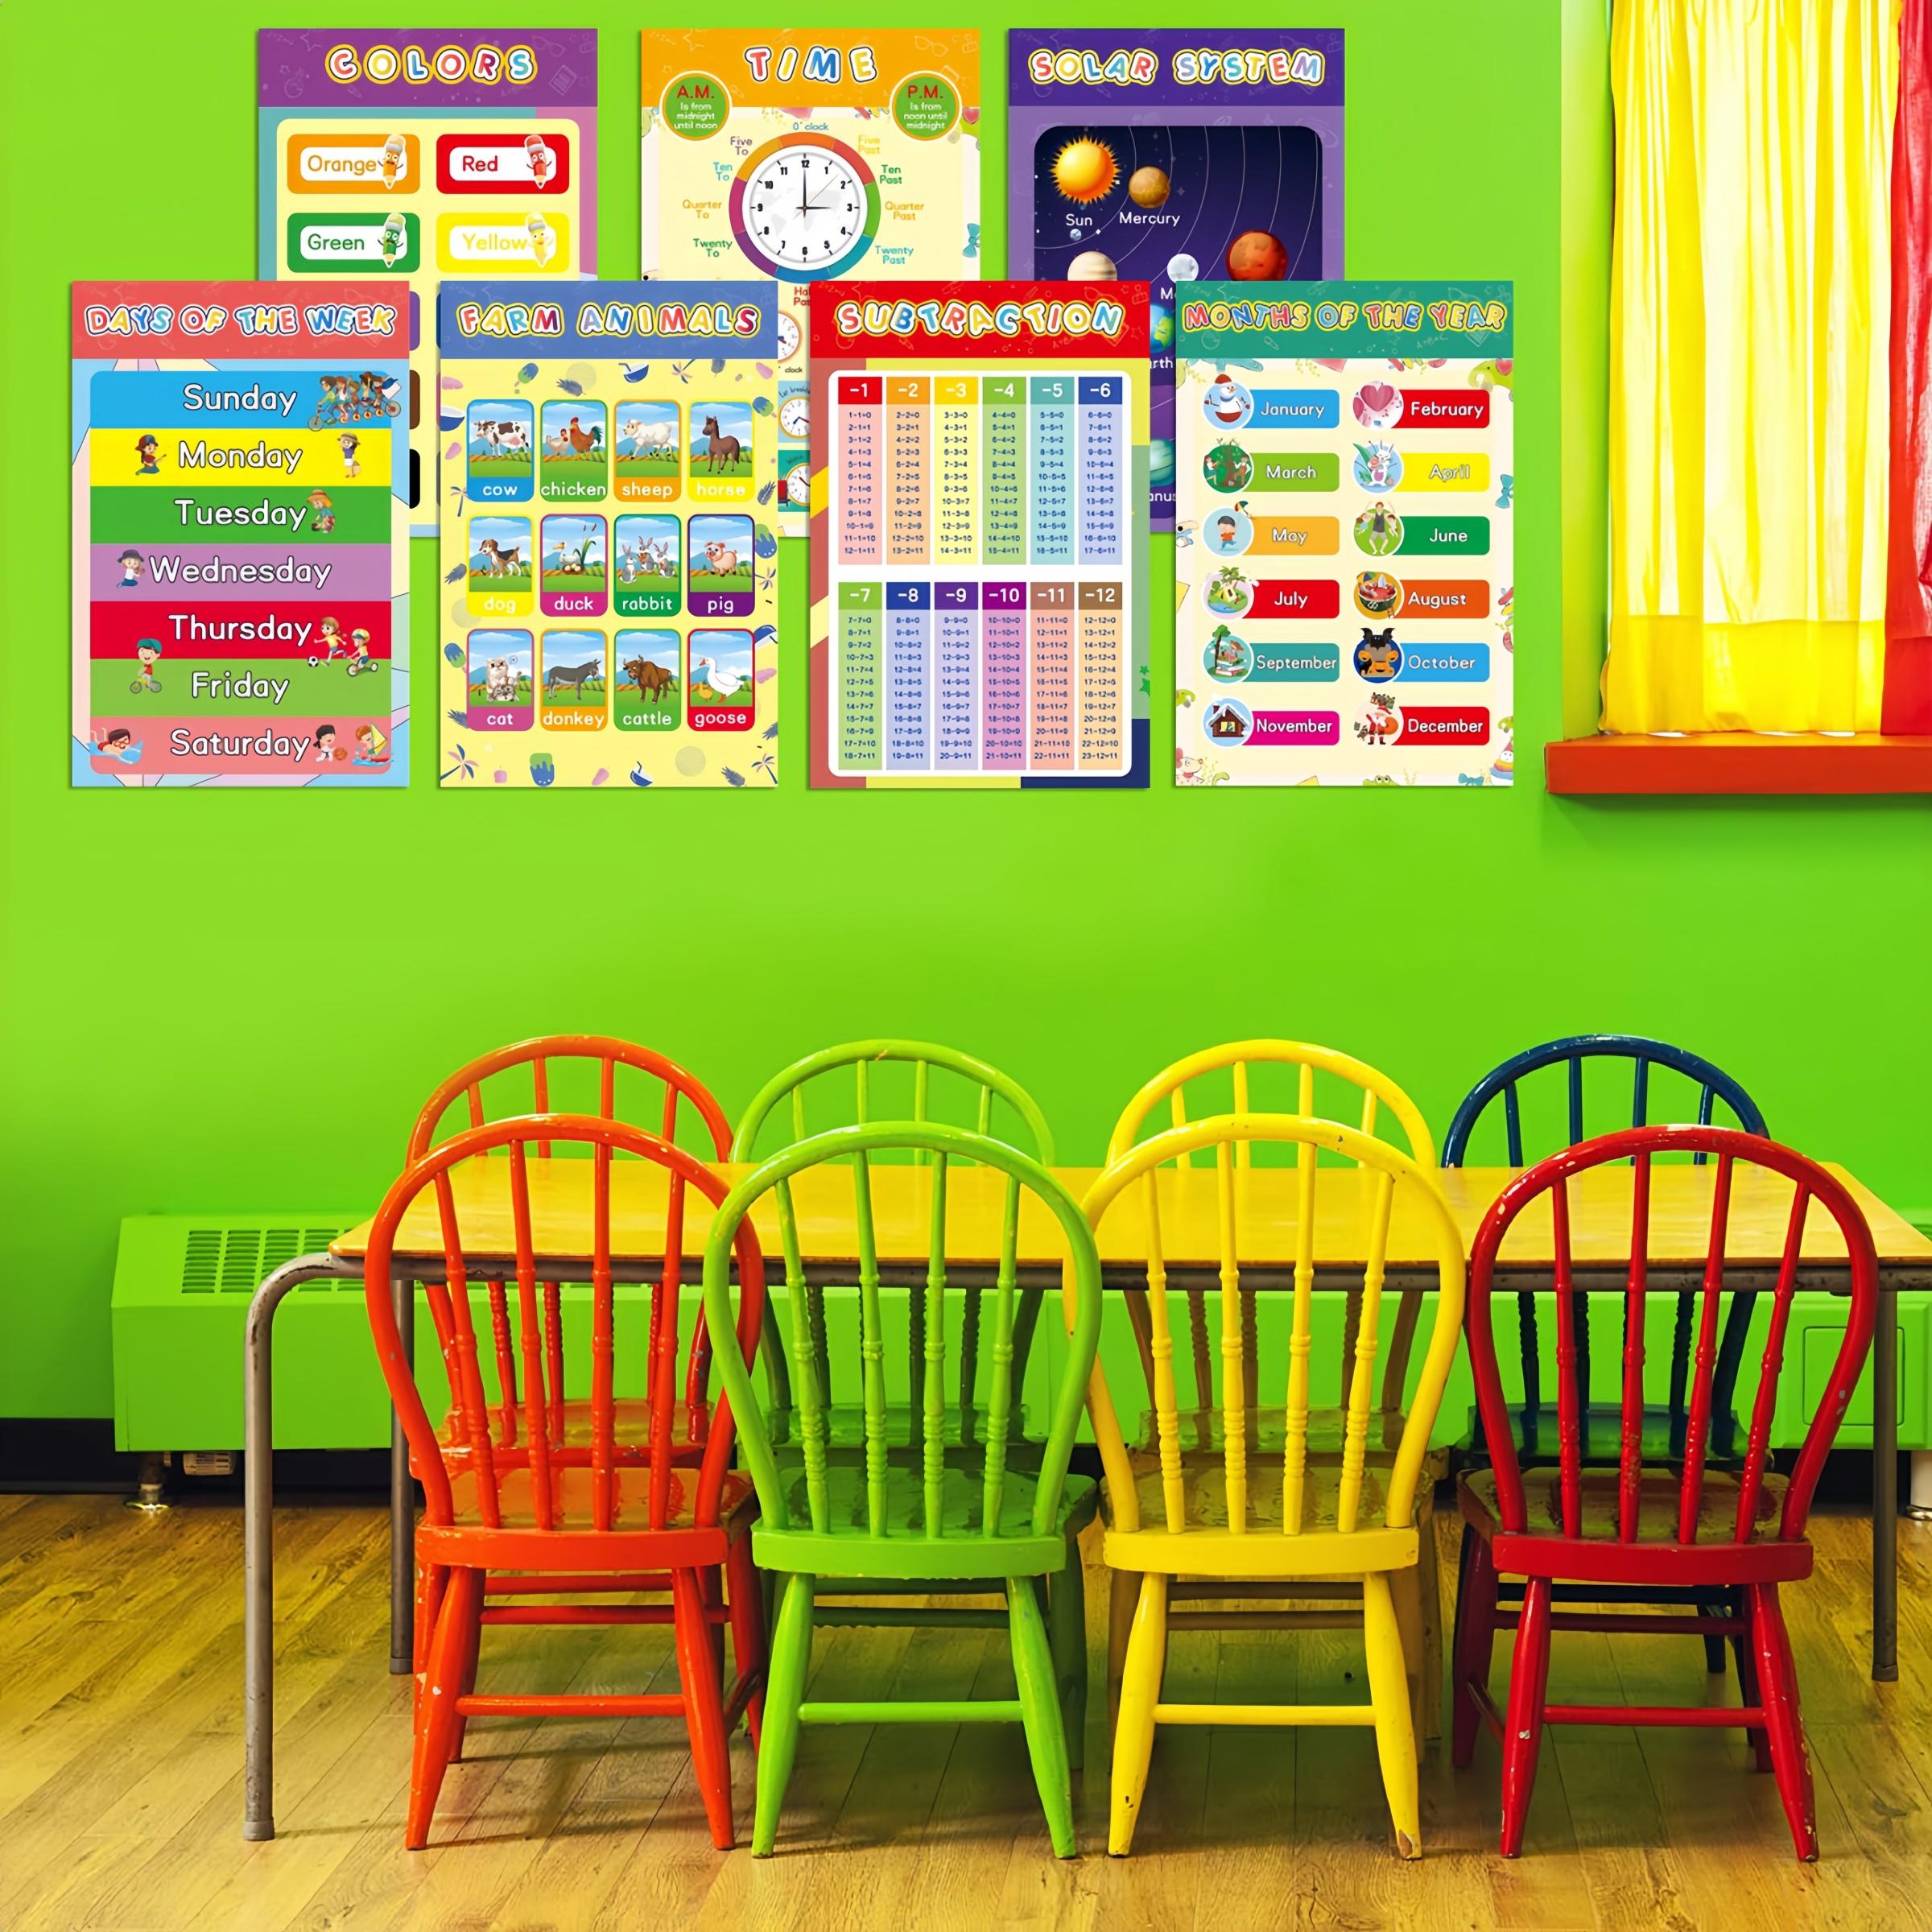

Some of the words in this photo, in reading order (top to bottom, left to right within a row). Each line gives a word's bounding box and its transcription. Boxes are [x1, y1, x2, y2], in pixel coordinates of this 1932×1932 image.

[327, 46, 536, 83] COLORS
[745, 47, 876, 83] TIME
[1030, 49, 1157, 85] SOLAR
[1174, 49, 1323, 85] SYSTEM
[677, 85, 714, 98] A.M.
[908, 85, 943, 98] P.M.
[691, 102, 712, 110] from
[921, 102, 941, 110] from
[677, 112, 715, 121] midnight
[906, 122, 944, 130] midnight
[730, 136, 752, 145] Five
[858, 135, 880, 144] Five
[735, 147, 749, 155] To
[858, 146, 880, 154] Past
[308, 155, 377, 175] Orange
[463, 156, 498, 171] Red
[713, 162, 732, 171] Ten
[801, 159, 809, 167] 12
[881, 164, 901, 173] Ten
[716, 172, 729, 180] To
[780, 167, 787, 175] 11
[824, 167, 828, 175] 1
[765, 180, 773, 189] 10
[840, 181, 845, 189] 2
[880, 175, 902, 184] Past
[683, 200, 721, 208] Quarter
[758, 203, 763, 212] 9
[847, 204, 852, 212] 3
[885, 201, 924, 211] Quarter
[696, 210, 709, 219] To
[894, 212, 915, 220] Past
[1066, 213, 1092, 227] Sun
[1119, 212, 1180, 227] Mercury
[764, 226, 769, 235] 8
[840, 226, 845, 235] 4
[308, 234, 365, 251] Green
[463, 234, 528, 251] Yellow
[693, 238, 732, 250] Twenty
[782, 240, 786, 249] 7
[824, 241, 830, 249] 5
[707, 249, 720, 257] To
[803, 246, 807, 255] 6
[876, 246, 914, 256] Twenty
[882, 256, 905, 264] Past
[85, 304, 173, 336] DAYS
[180, 306, 227, 336] OF
[234, 304, 299, 336] THE
[305, 304, 396, 336] WEEK
[457, 303, 563, 336] FARM
[578, 303, 760, 337] ANIMALS
[836, 302, 1125, 336] SUBTRACTION
[1183, 301, 1309, 332] MONTHS
[1317, 302, 1356, 330] OF
[1364, 301, 1422, 331] THE
[1430, 301, 1505, 332] YEAR
[850, 383, 868, 398] -1
[898, 383, 918, 398] -2
[946, 383, 966, 398] -3
[994, 383, 1014, 398] -4
[1042, 383, 1063, 398] -5
[1090, 383, 1111, 398] -6
[182, 383, 296, 416] Sunday
[1261, 402, 1324, 419] January
[1410, 401, 1484, 419] February
[178, 441, 303, 474] Monday
[1266, 465, 1316, 478] March
[1430, 464, 1470, 481] April
[484, 485, 517, 496] cow
[541, 483, 606, 496] chicken
[622, 483, 673, 499] sheep
[696, 483, 745, 496] horse
[174, 499, 308, 531] Tuesday
[1272, 529, 1308, 544] May
[1430, 529, 1468, 543] June
[149, 555, 332, 589] Wednesday
[850, 588, 870, 602] -7
[898, 588, 919, 602] -8
[946, 588, 966, 602] -9
[989, 588, 1019, 602] -10
[1038, 588, 1064, 602] -11
[1085, 588, 1114, 602] -12
[1274, 592, 1307, 609] July
[1408, 592, 1467, 607] August
[485, 597, 516, 613] dog
[554, 597, 593, 610] duck
[622, 597, 672, 611] rabbit
[707, 598, 734, 613] pig
[168, 614, 312, 646] Thursday
[1257, 655, 1336, 673] September
[1409, 655, 1475, 670] October
[191, 671, 289, 704] Friday
[486, 712, 514, 725] cat
[543, 710, 604, 728] donkey
[623, 712, 671, 725] cattle
[696, 712, 746, 726] goose
[1257, 719, 1331, 733] November
[1407, 719, 1483, 733] December
[171, 729, 310, 762] Saturday
